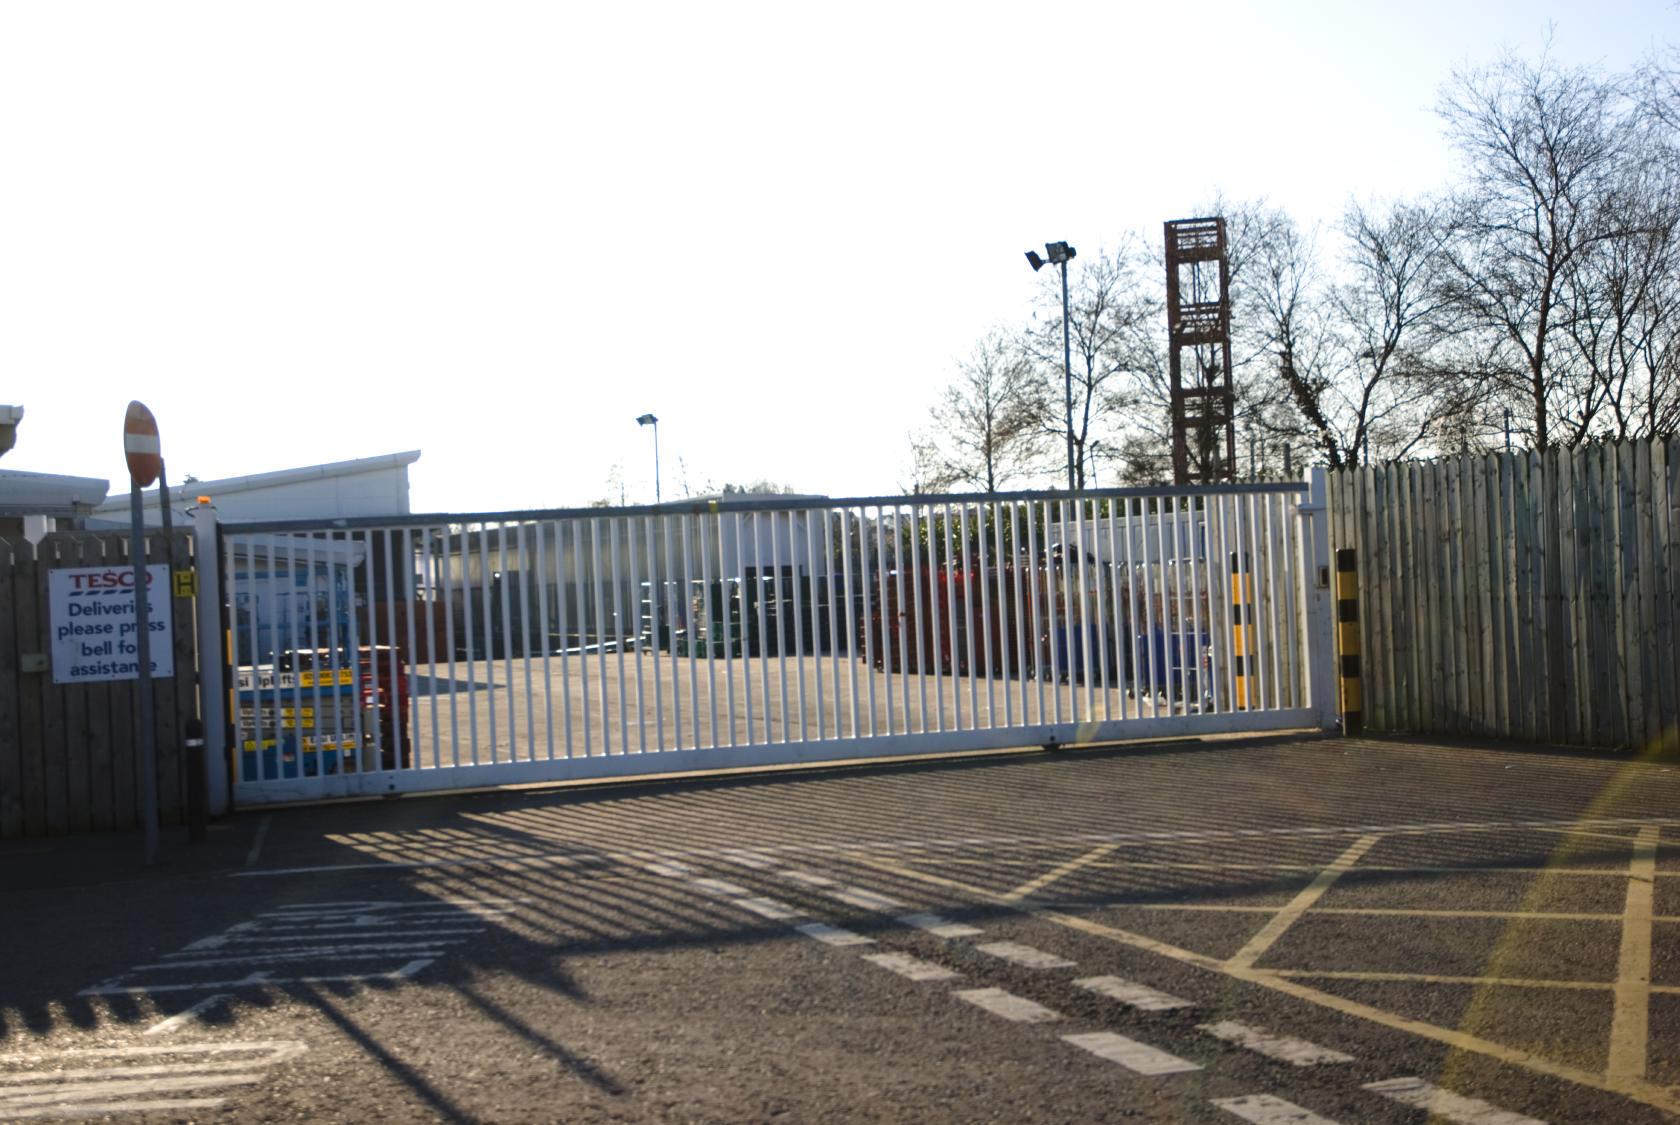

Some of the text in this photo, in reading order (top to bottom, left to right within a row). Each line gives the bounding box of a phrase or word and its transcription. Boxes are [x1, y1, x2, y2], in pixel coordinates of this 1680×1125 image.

[68, 601, 154, 617] Deliveris
[58, 620, 165, 641] please prss
[81, 639, 138, 657] bell fo
[70, 660, 158, 677] assistane
